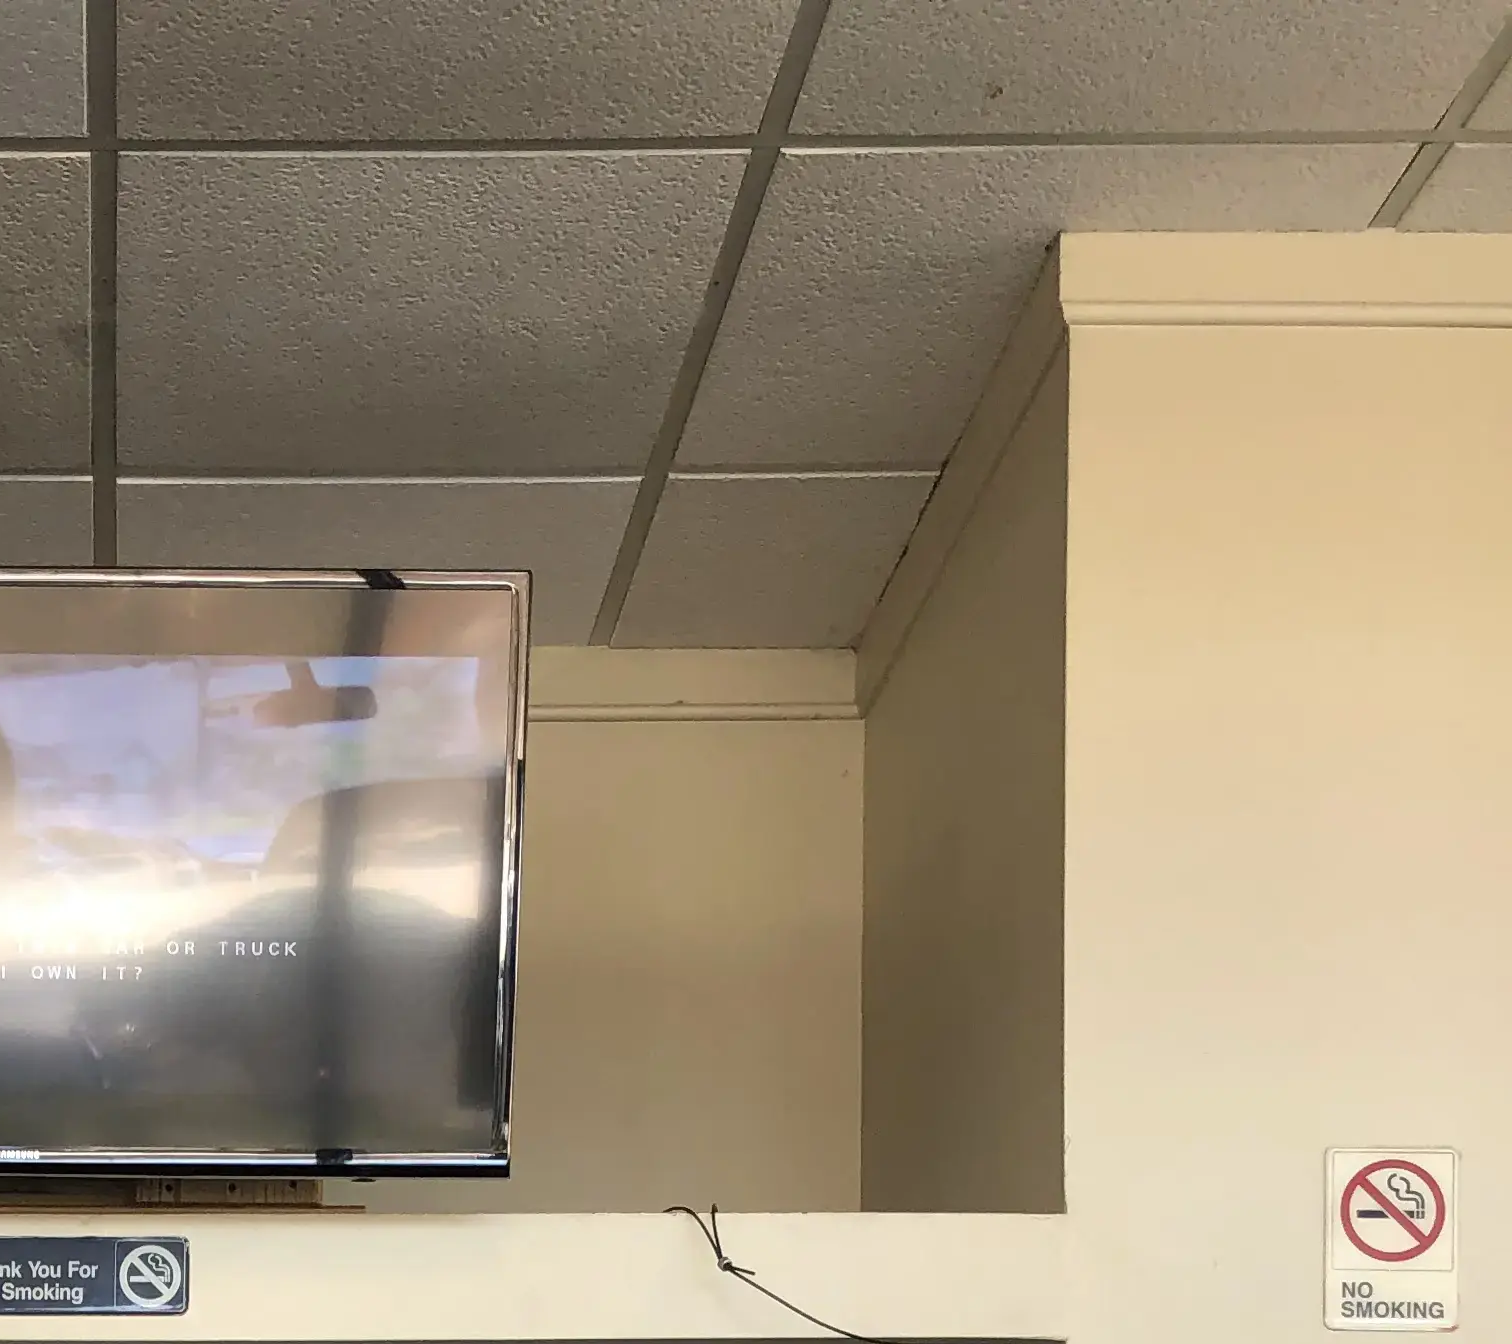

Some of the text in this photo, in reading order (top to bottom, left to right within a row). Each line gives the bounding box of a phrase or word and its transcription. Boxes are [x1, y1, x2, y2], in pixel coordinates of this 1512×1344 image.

[166, 941, 196, 955] OR
[218, 941, 297, 957] TRUCK
[31, 965, 77, 980] OWN
[101, 966, 143, 981] IT?
[25, 1260, 62, 1278] You
[68, 1260, 99, 1278] For
[1, 1282, 85, 1305] Smoking
[1341, 1281, 1373, 1298] NO
[1341, 1301, 1445, 1319] SMOKING
